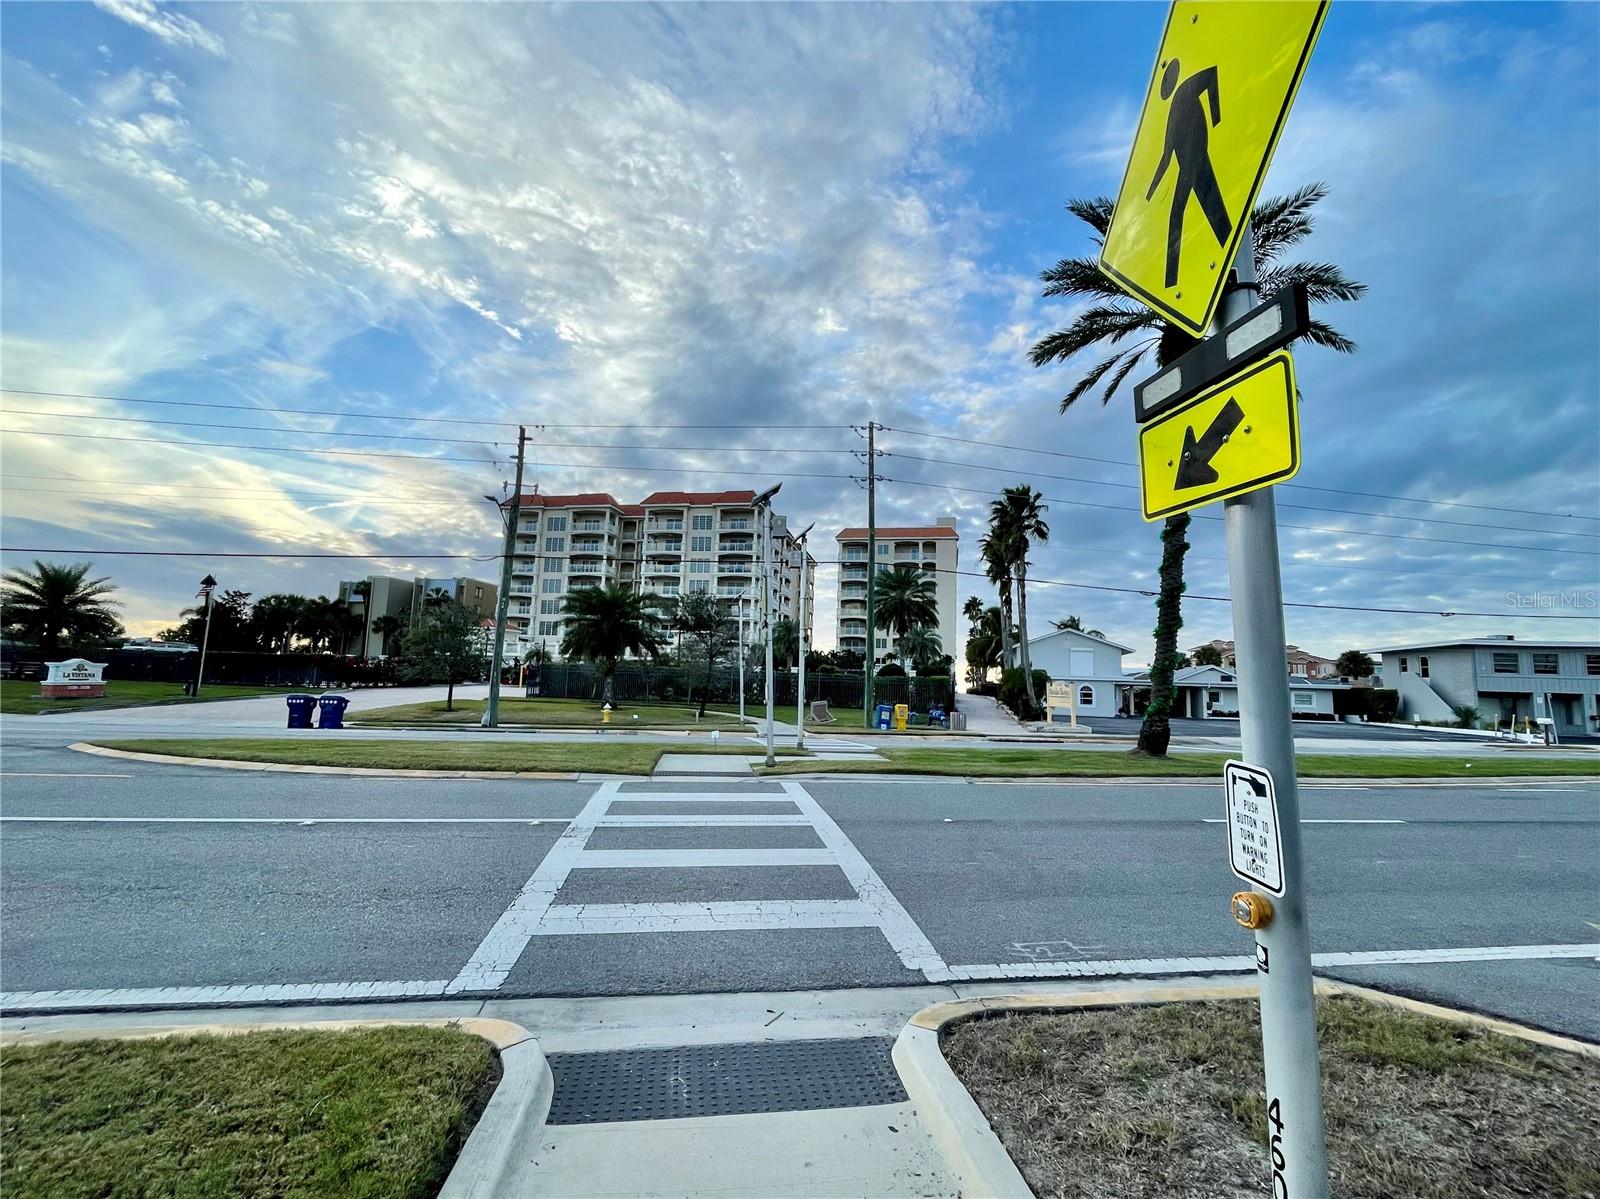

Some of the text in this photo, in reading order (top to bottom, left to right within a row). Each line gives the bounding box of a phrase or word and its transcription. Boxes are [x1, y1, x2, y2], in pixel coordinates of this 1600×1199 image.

[1243, 799, 1259, 814] PUSH
[1236, 812, 1269, 834] BUTTON TO
[1240, 827, 1268, 849] TURN ON
[1242, 844, 1268, 864] WARNING
[1246, 860, 1266, 879] LIGHTS
